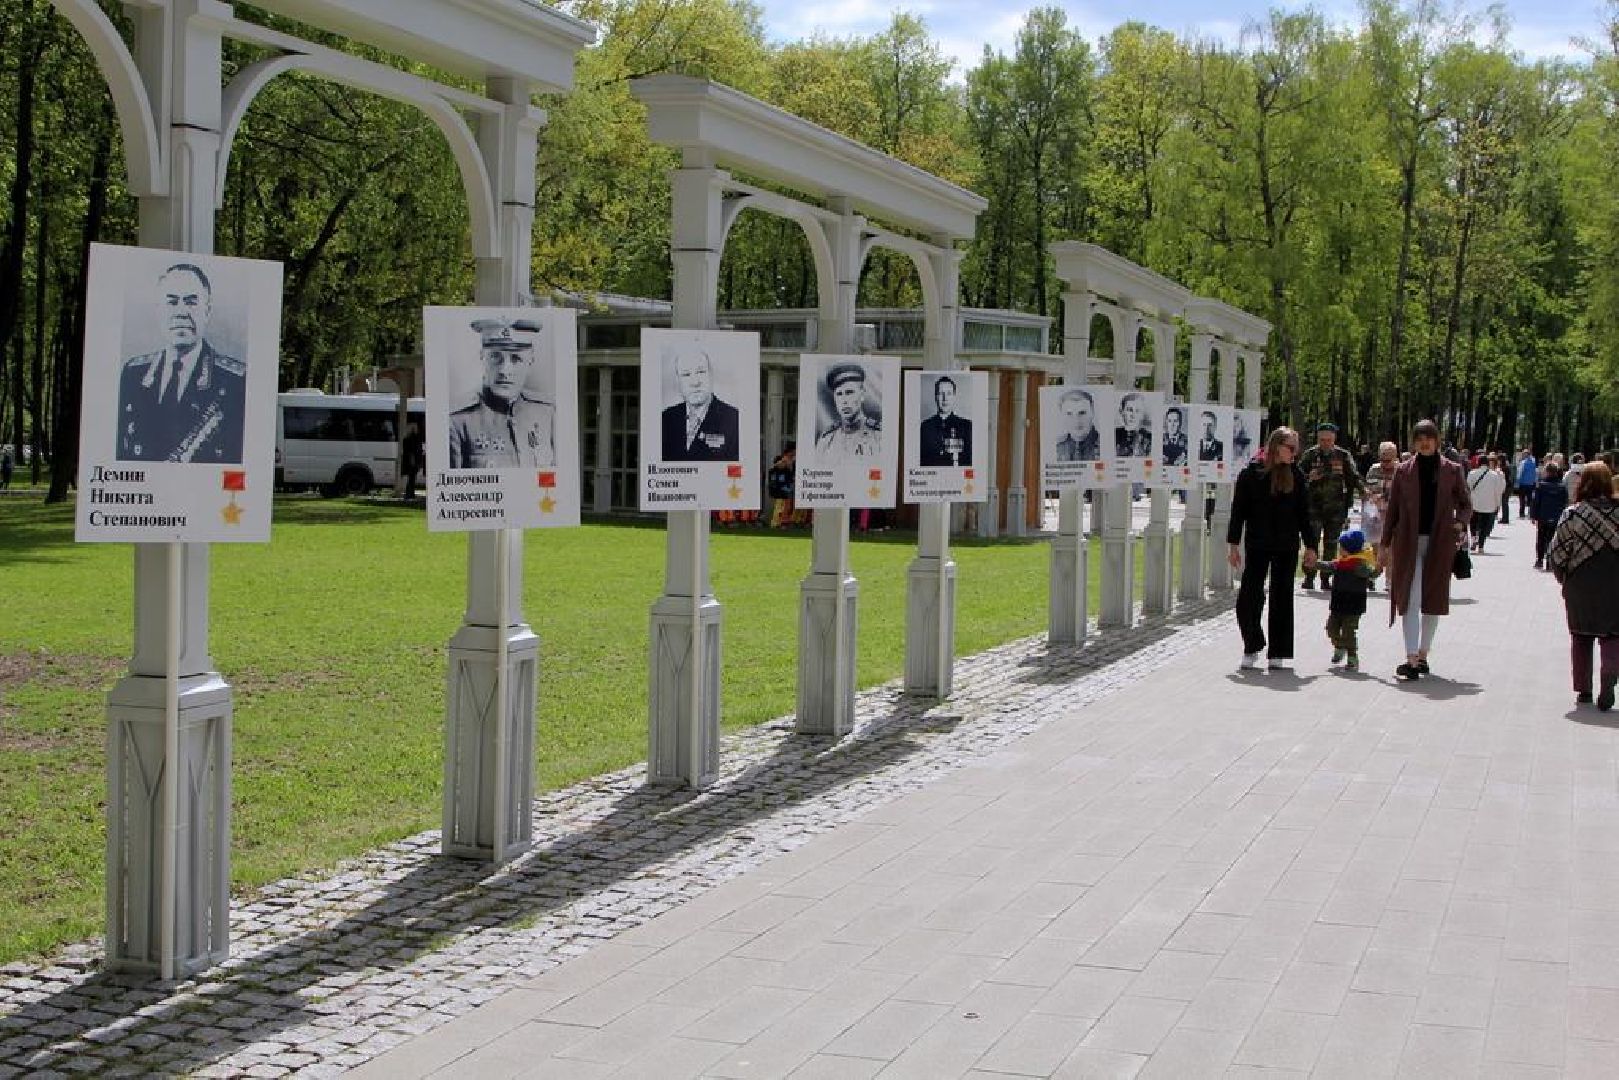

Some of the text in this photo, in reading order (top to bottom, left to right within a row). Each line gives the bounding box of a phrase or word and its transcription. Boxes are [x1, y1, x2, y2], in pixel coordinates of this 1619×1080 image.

[90, 465, 146, 483] Демин
[90, 487, 154, 505] Никита
[437, 490, 503, 504] Александр
[648, 492, 697, 502] Иванович
[89, 510, 188, 527] Степанович
[437, 507, 505, 521] Андреевич
